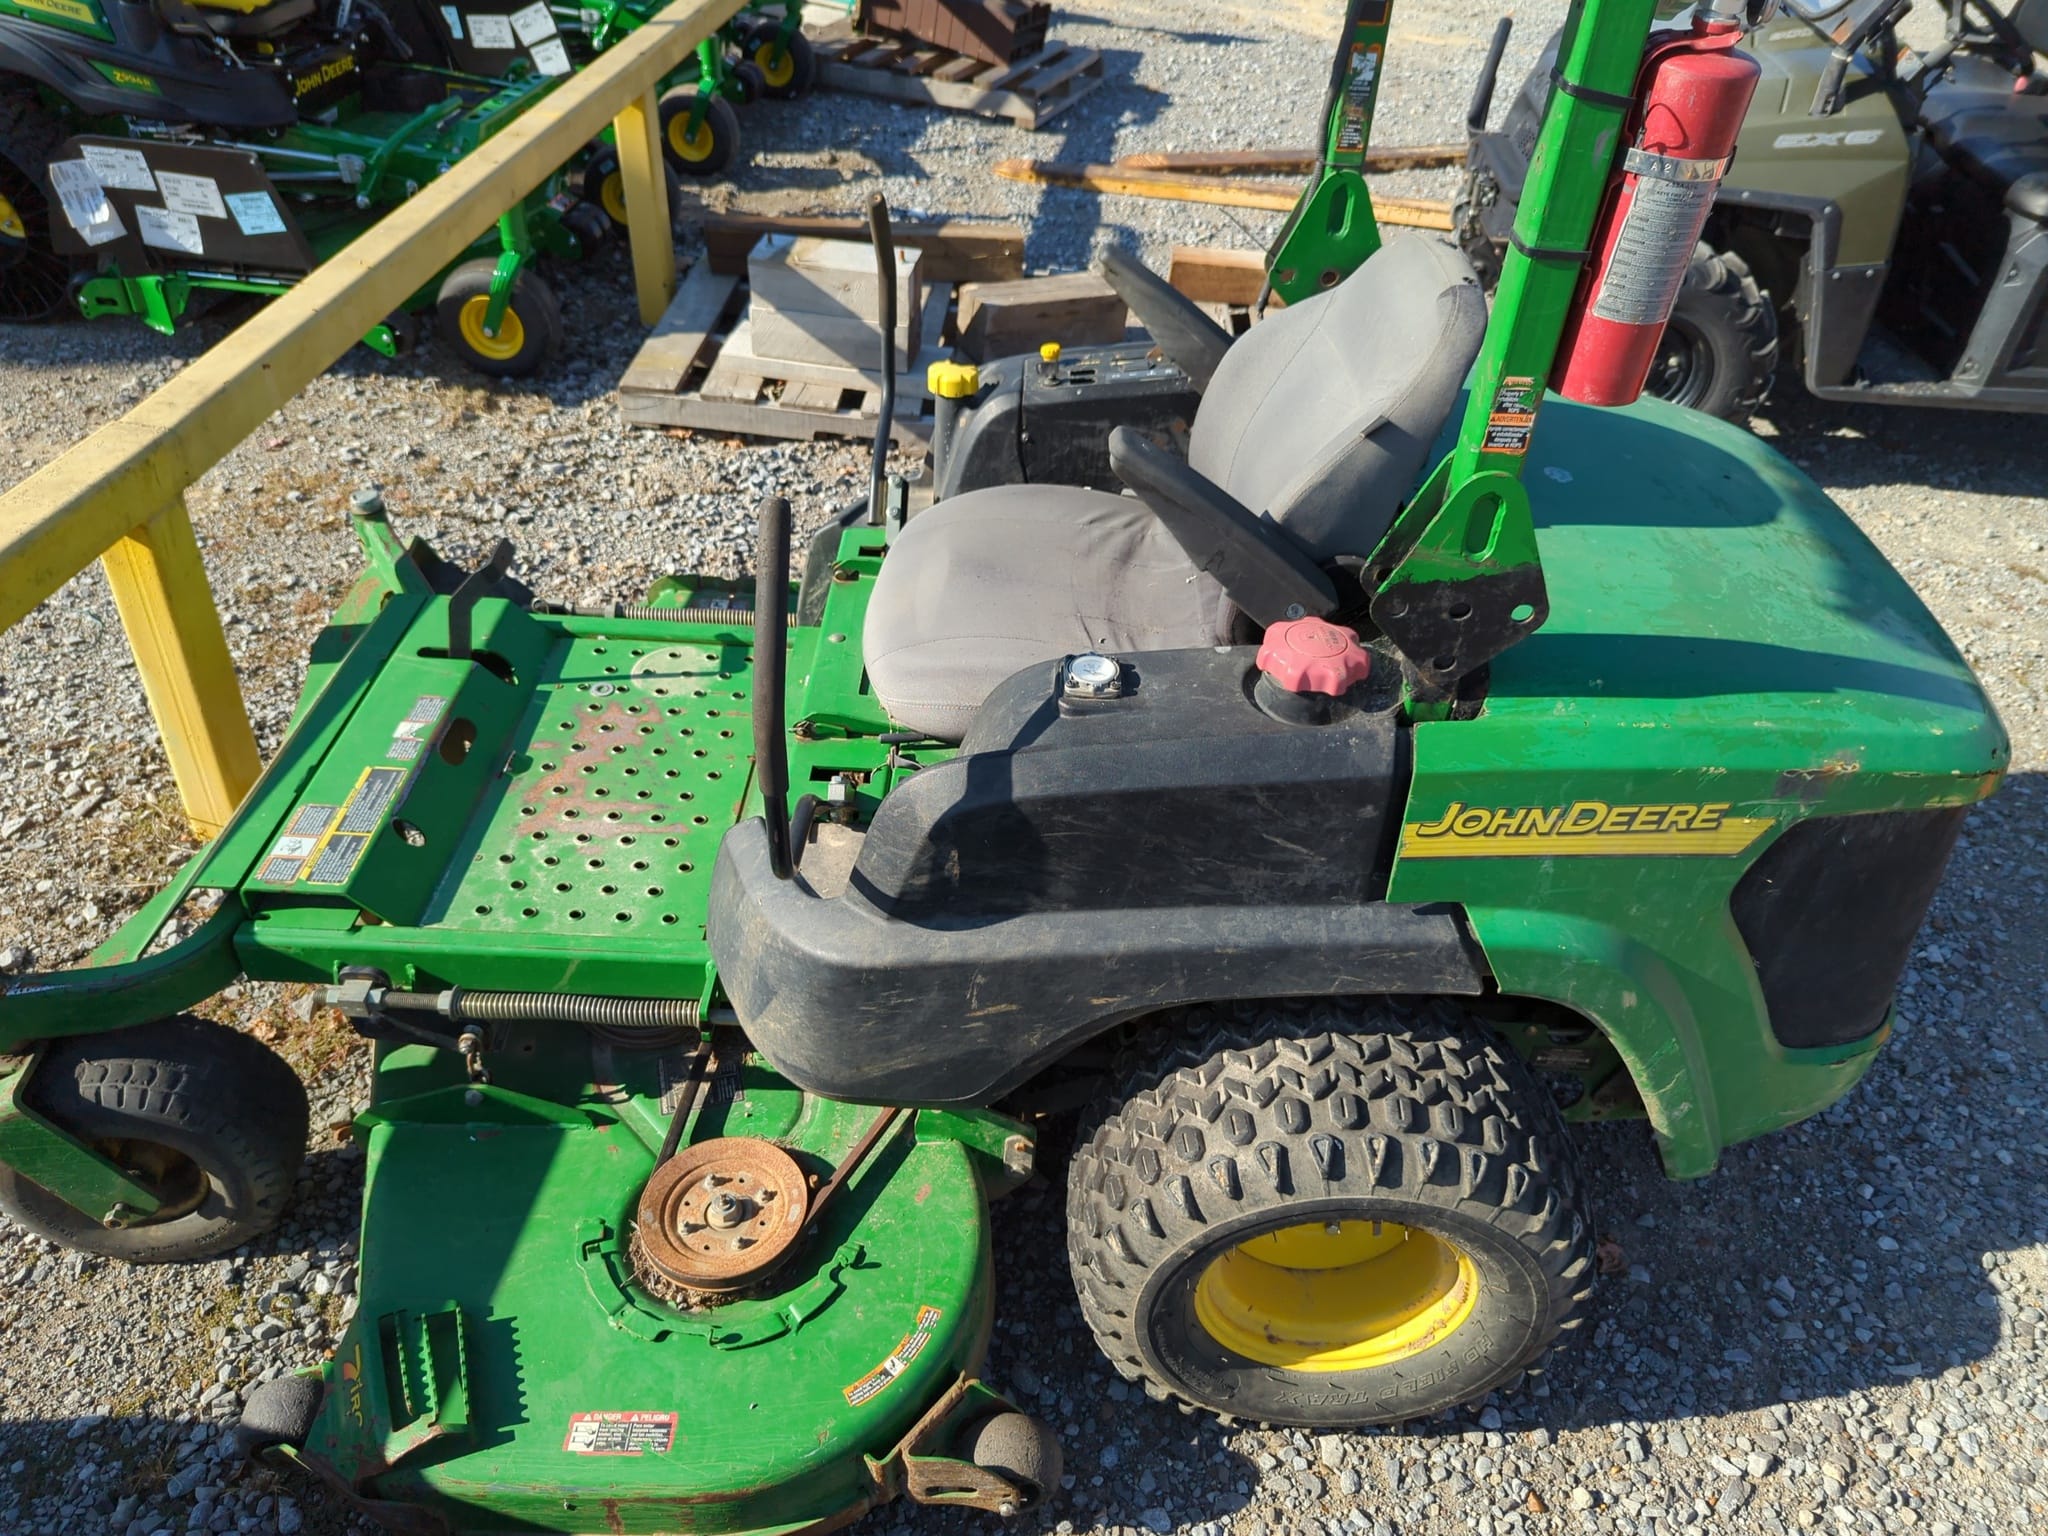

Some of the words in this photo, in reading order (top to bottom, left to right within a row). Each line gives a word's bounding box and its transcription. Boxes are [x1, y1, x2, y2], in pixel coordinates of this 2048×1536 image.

[296, 72, 322, 97] JOHN
[321, 54, 355, 83] DEERE
[1417, 802, 1562, 838] JOHN
[1558, 800, 1733, 835] DEERE
[1274, 1391, 1370, 1406] TRAX
[1378, 1360, 1461, 1400] FIELD
